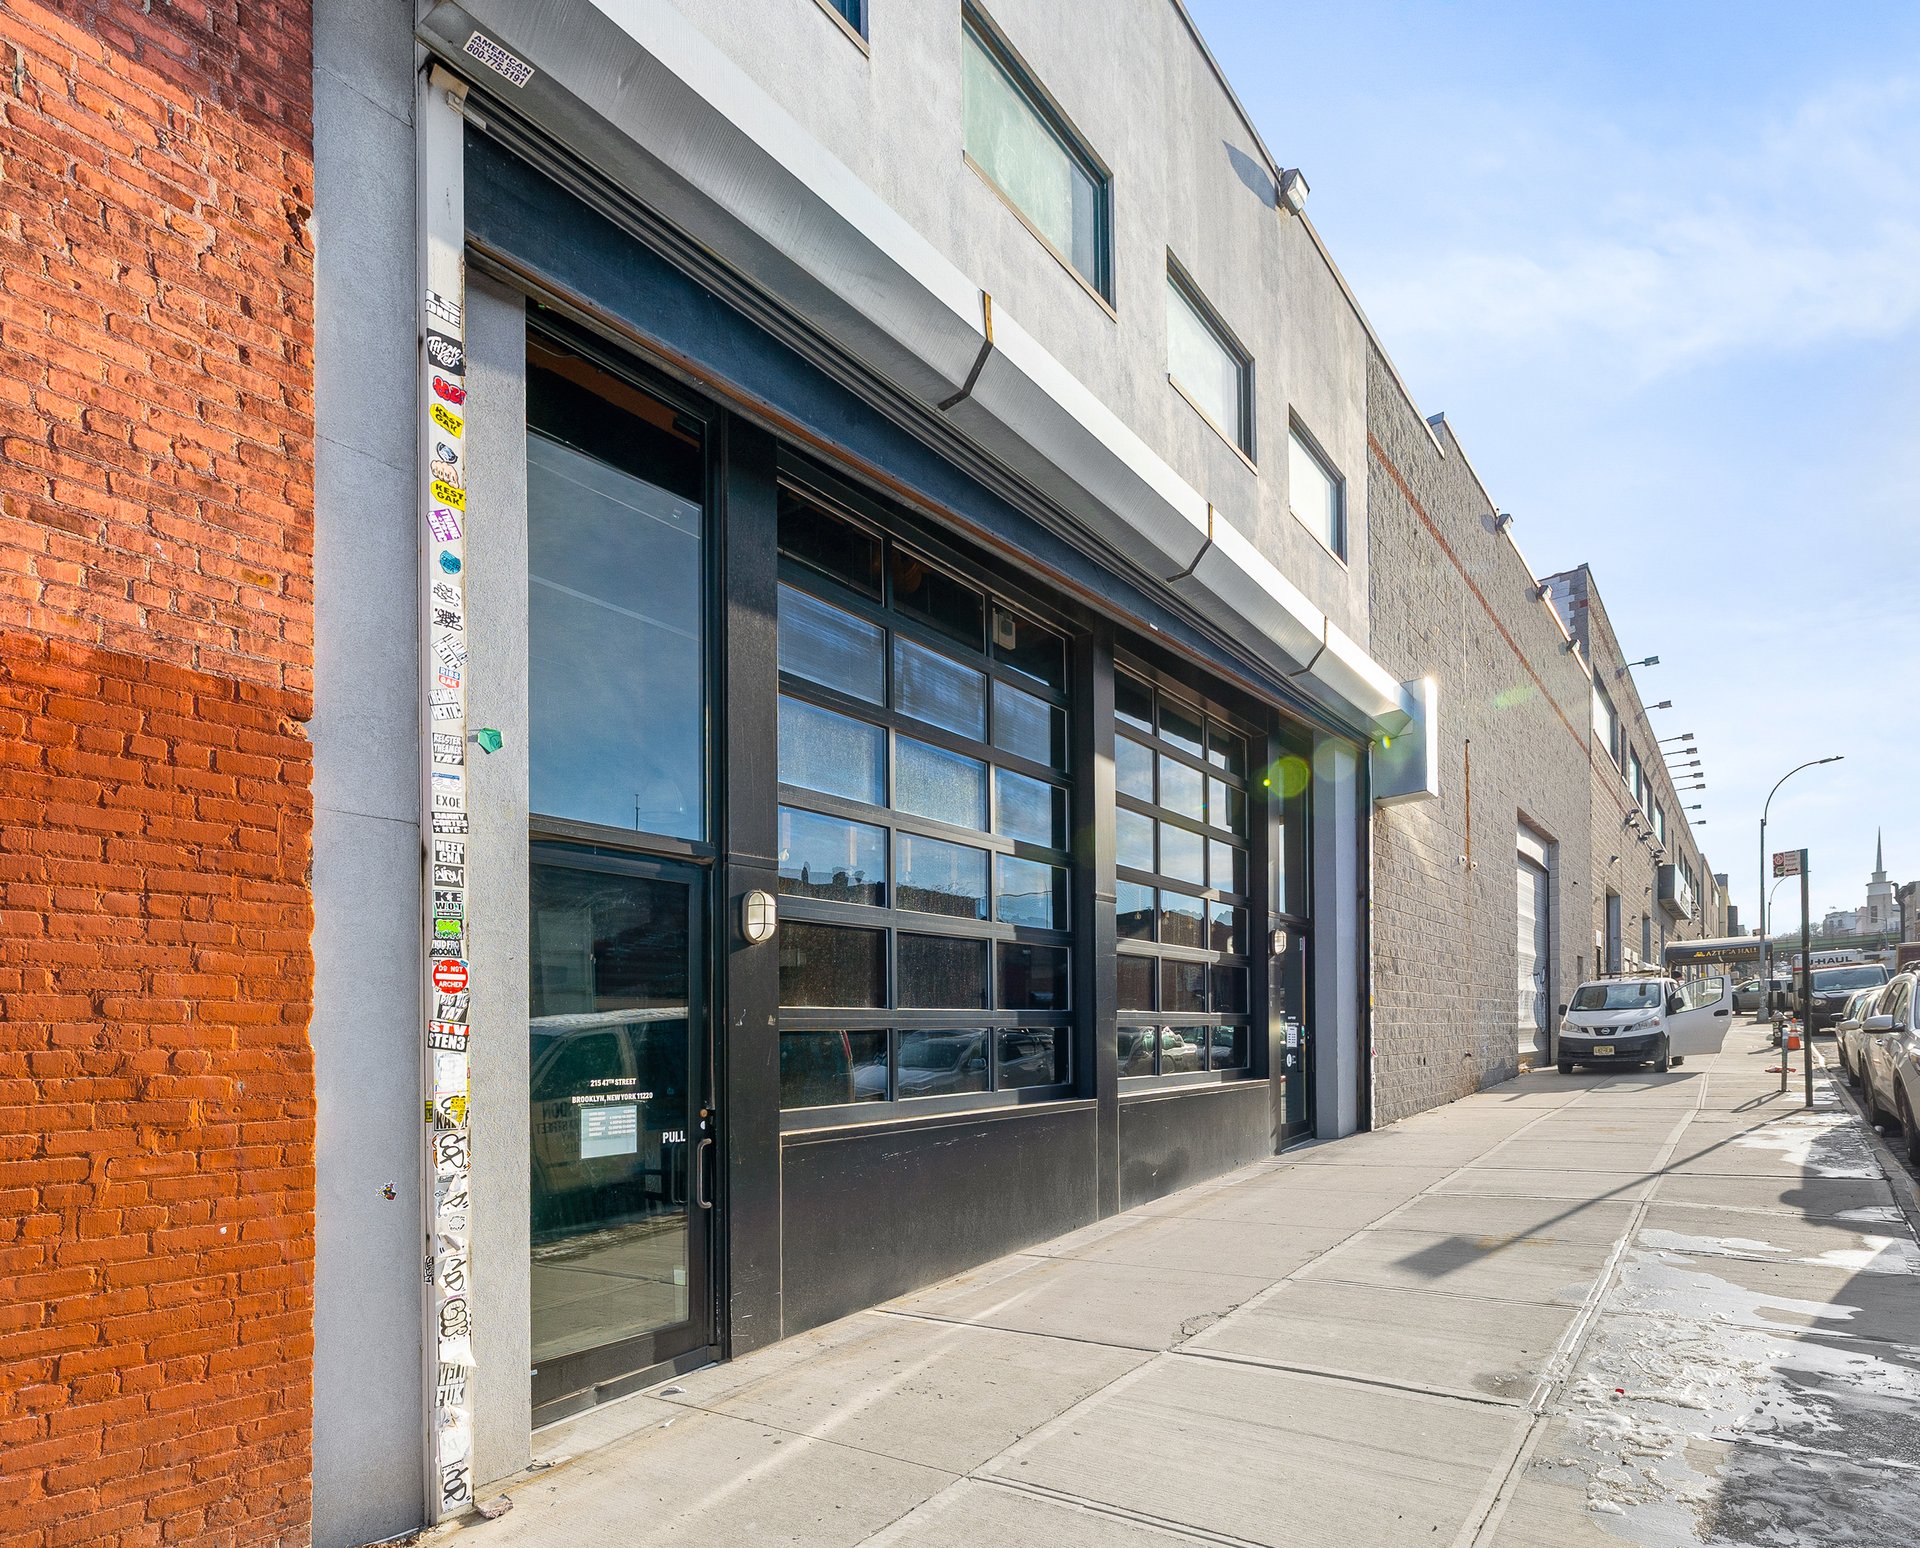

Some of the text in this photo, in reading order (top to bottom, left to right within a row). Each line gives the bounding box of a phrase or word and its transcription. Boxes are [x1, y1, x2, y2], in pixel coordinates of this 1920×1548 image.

[471, 39, 529, 79] ROLLING DOOR
[474, 35, 531, 75] AMERICAN
[467, 44, 525, 85] 800-775-5191
[425, 299, 460, 328] ONE
[435, 406, 462, 428] KEST
[435, 483, 464, 500] KEST
[437, 491, 459, 506] GAK
[435, 840, 464, 854] MEEK
[439, 851, 461, 864] CNA
[450, 965, 464, 973] NOT
[430, 1021, 467, 1036] STV
[428, 1032, 466, 1051] STEN3
[590, 1079, 601, 1087] 215
[571, 1095, 607, 1104] BROOKLYN,
[662, 1130, 686, 1144] PULL
